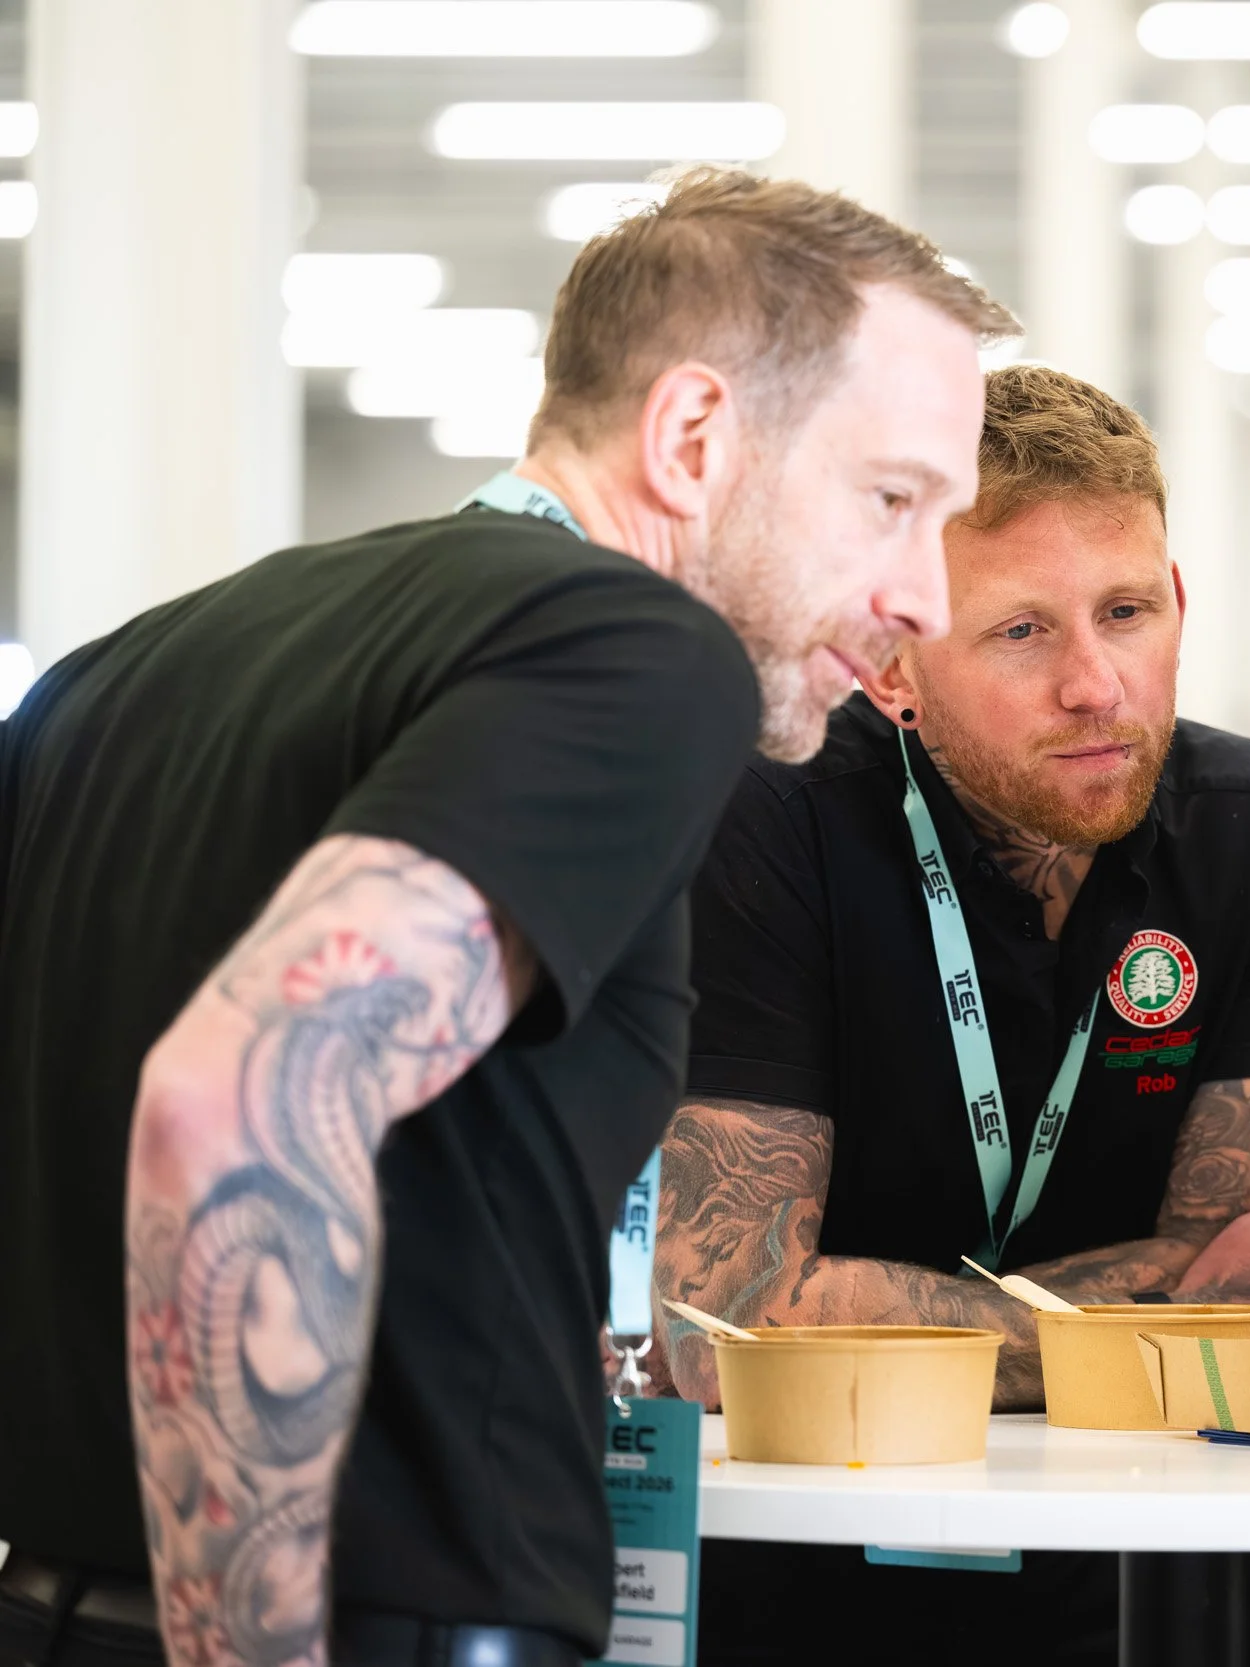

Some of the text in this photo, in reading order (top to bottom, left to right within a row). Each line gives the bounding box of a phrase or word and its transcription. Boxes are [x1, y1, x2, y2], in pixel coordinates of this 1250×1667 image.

[1110, 980, 1147, 1023] QUALITY
[1162, 972, 1194, 1021] SERVICE
[1136, 1073, 1177, 1097] Rob
[612, 1425, 657, 1453] EC
